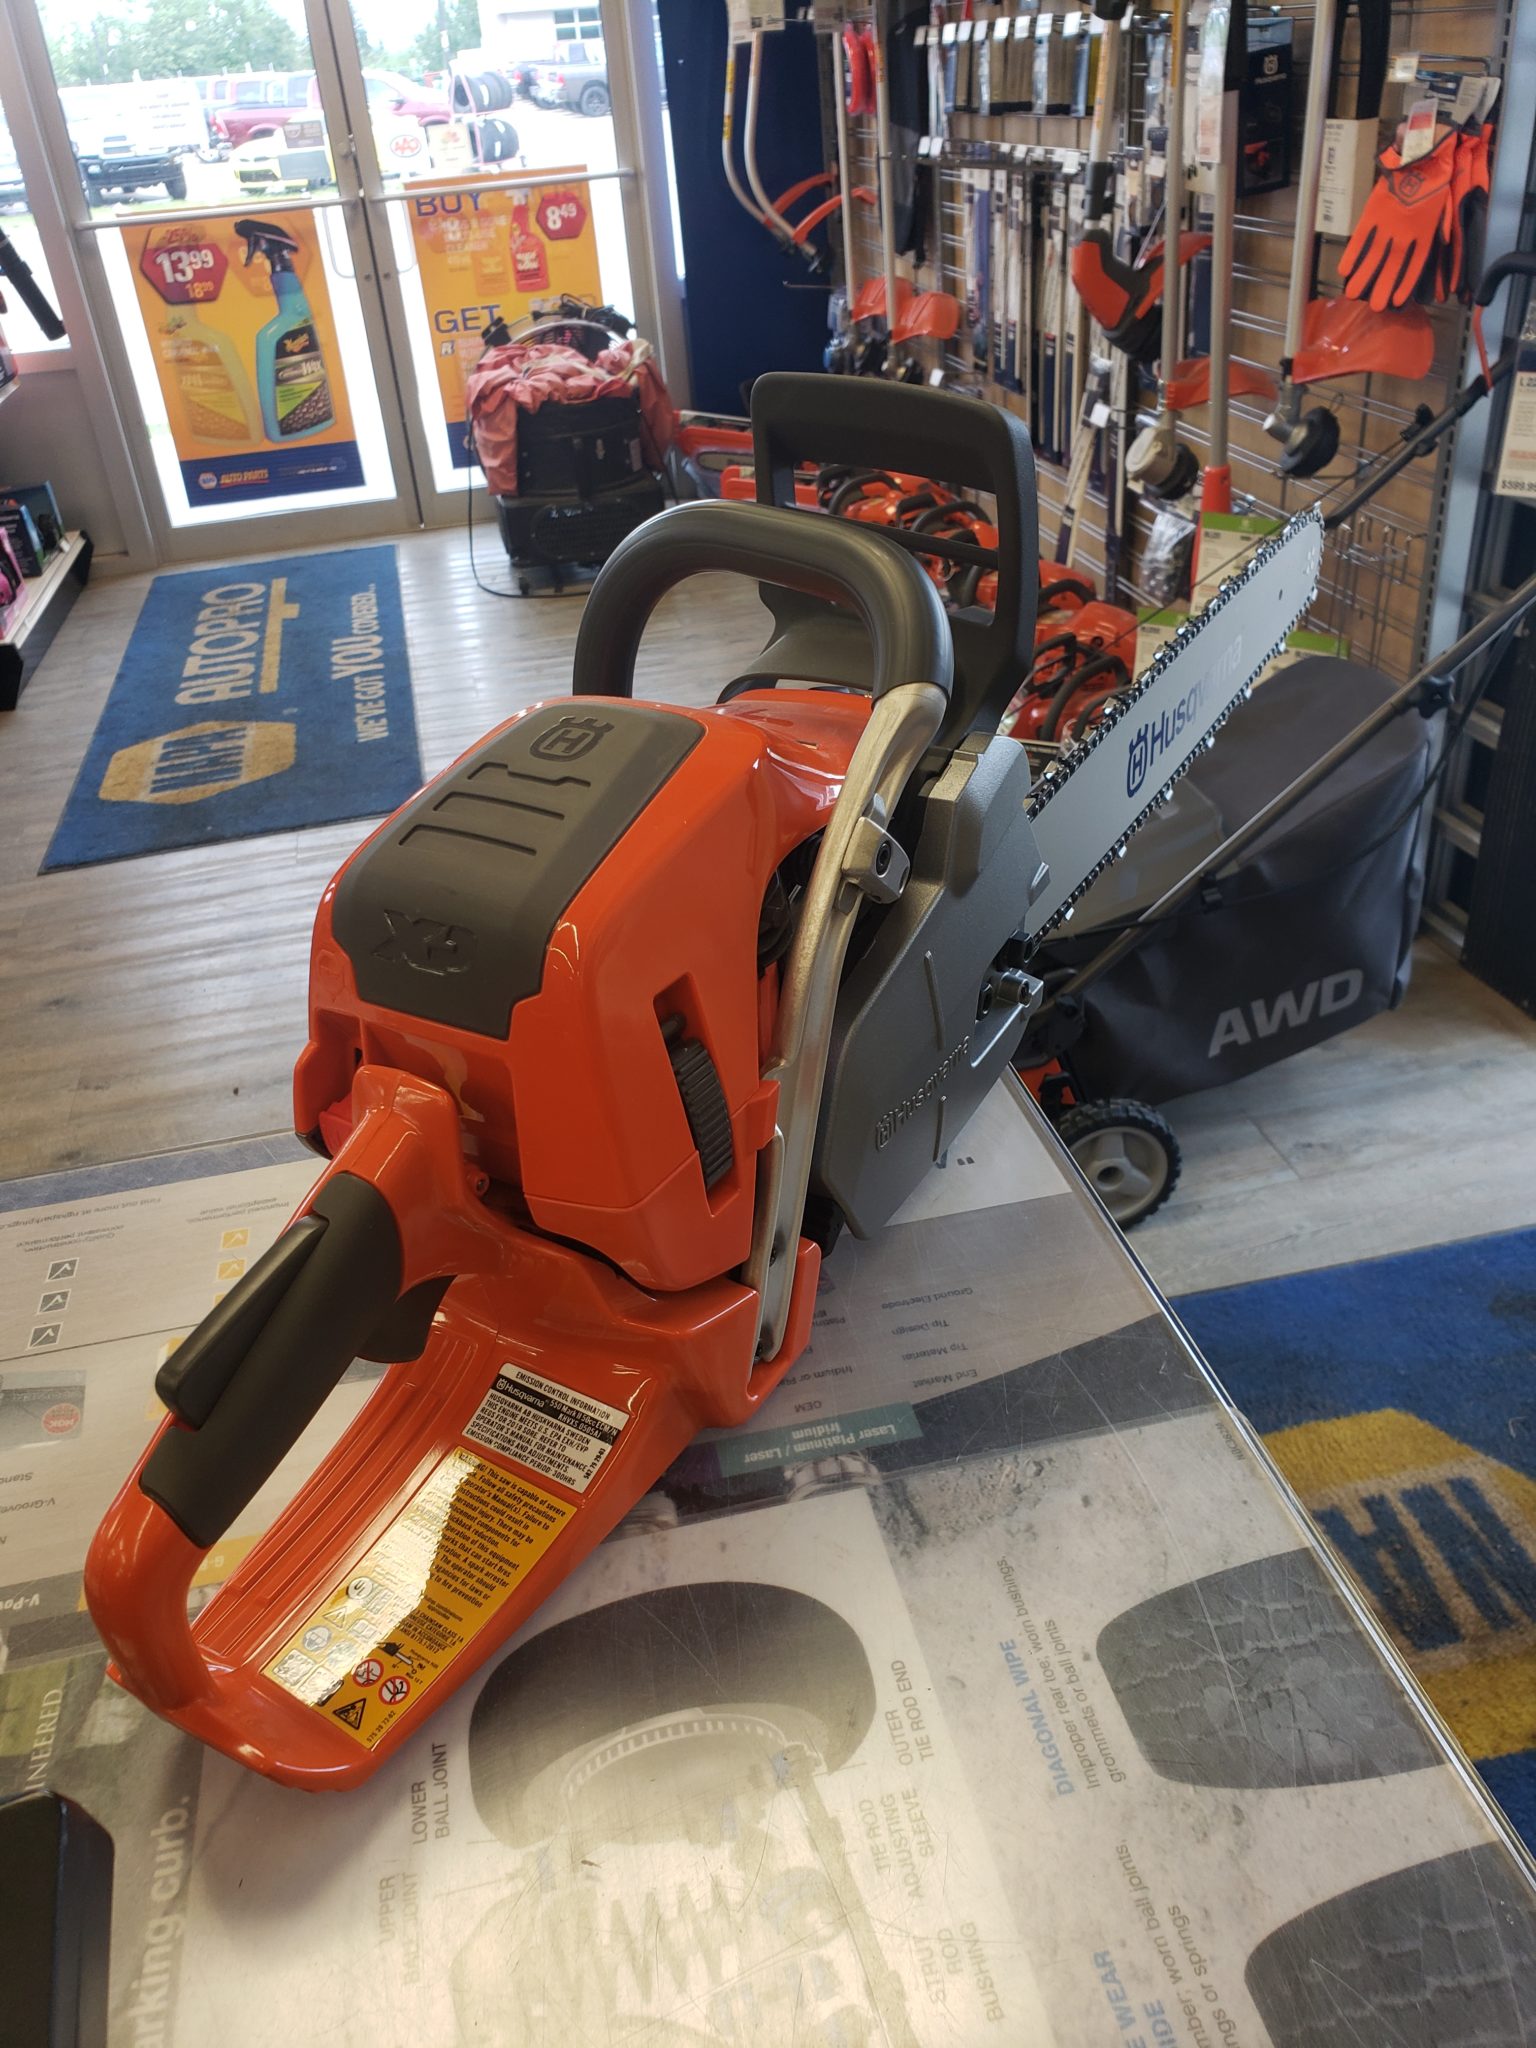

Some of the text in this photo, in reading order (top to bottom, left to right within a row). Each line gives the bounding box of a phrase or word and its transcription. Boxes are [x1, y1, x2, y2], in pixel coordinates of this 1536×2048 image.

[415, 193, 481, 216] BUY
[434, 305, 500, 333] GET
[220, 470, 241, 484] AUTO
[243, 468, 269, 482] PARTS
[174, 582, 266, 705] AUTOPRO
[331, 634, 385, 680] YOU
[354, 677, 386, 700] GOT
[1150, 635, 1242, 766] Husqvarna
[1208, 969, 1364, 1059] AWD
[880, 1286, 973, 1310] Ground Electrode
[891, 1318, 949, 1336] Tip Design
[901, 1341, 968, 1363] Tip Material
[812, 1364, 852, 1379] Iridium
[911, 1367, 977, 1389] End Market
[503, 1382, 547, 1408] Husqvarna
[514, 1371, 611, 1420] EMISSION CONTROL INFORMATION
[548, 1399, 563, 1410] 550
[560, 1404, 578, 1417] Mark
[792, 1398, 822, 1413] OEM
[469, 1420, 515, 1446] SPECIFICATIONS
[513, 1441, 528, 1453] AND
[479, 1406, 496, 1418] REGS
[494, 1413, 507, 1423] FOR
[506, 1419, 523, 1431] 2019
[538, 1434, 558, 1448] REFER
[557, 1443, 567, 1452] TO
[484, 1399, 498, 1410] THIS
[497, 1405, 519, 1420] ENGINE
[517, 1415, 539, 1429] MEETS
[548, 1430, 562, 1441] EPA
[488, 1392, 591, 1445] HUSQVARNA AB HUSKVARNA SWEDEN
[791, 1420, 841, 1441] Iridium
[857, 1423, 896, 1441] Laser
[465, 1427, 493, 1445] EMISSION
[492, 1441, 529, 1462] COMPLIANCE
[508, 1429, 534, 1446] MANUAL
[532, 1441, 546, 1452] FOR
[544, 1447, 587, 1472] MAINTENANCE
[741, 1446, 782, 1464] Laser
[792, 1431, 855, 1455] Platinum
[477, 1474, 558, 1523] Follow all safety precautions
[485, 1468, 501, 1479] This
[498, 1477, 512, 1486] saw
[515, 1486, 540, 1502] capable
[545, 1503, 566, 1516] severe
[475, 1519, 521, 1547] components for
[488, 1504, 507, 1516] could
[503, 1513, 524, 1526] result
[494, 1518, 514, 1531] There
[510, 1529, 525, 1540] may
[523, 1536, 534, 1544] be
[520, 1511, 544, 1526] Failure
[541, 1522, 551, 1530] to
[438, 1553, 500, 1591] The operator should
[457, 1542, 512, 1577] that can start fires
[466, 1560, 485, 1573] spark
[482, 1570, 510, 1587] arrester
[476, 1541, 491, 1552] this
[487, 1549, 521, 1570] equipment
[441, 1578, 455, 1588] fire
[448, 1584, 488, 1608] prevention
[458, 1576, 473, 1587] for
[466, 1583, 486, 1596] laws
[1022, 1618, 1044, 1654] worn
[891, 1659, 935, 1762] TIE ROD END
[999, 1638, 1076, 1796] DIAGONAL WIPE
[1045, 1618, 1126, 1783] grommets or ball joints
[1049, 1687, 1068, 1712] rear
[24, 1688, 63, 1792] INEERED
[885, 1709, 913, 1766] OUTER
[1063, 1718, 1101, 1790] Improper
[432, 1743, 450, 1839] BALL JOINT
[411, 1779, 428, 1845] LOWER
[902, 1788, 934, 1857] SLEEVE
[859, 1799, 891, 1876] TIE ROD
[880, 1793, 924, 1899] ADJUSTING
[379, 1874, 396, 1943] UPPER
[402, 1872, 418, 1922] JOINT
[1135, 1896, 1160, 1932] ball
[937, 1927, 963, 1976] ROD
[1154, 1935, 1184, 1985] worn
[1169, 1904, 1219, 2004] or springs
[959, 1921, 1005, 2023] BUSHING
[1093, 1950, 1137, 2031] WEAR
